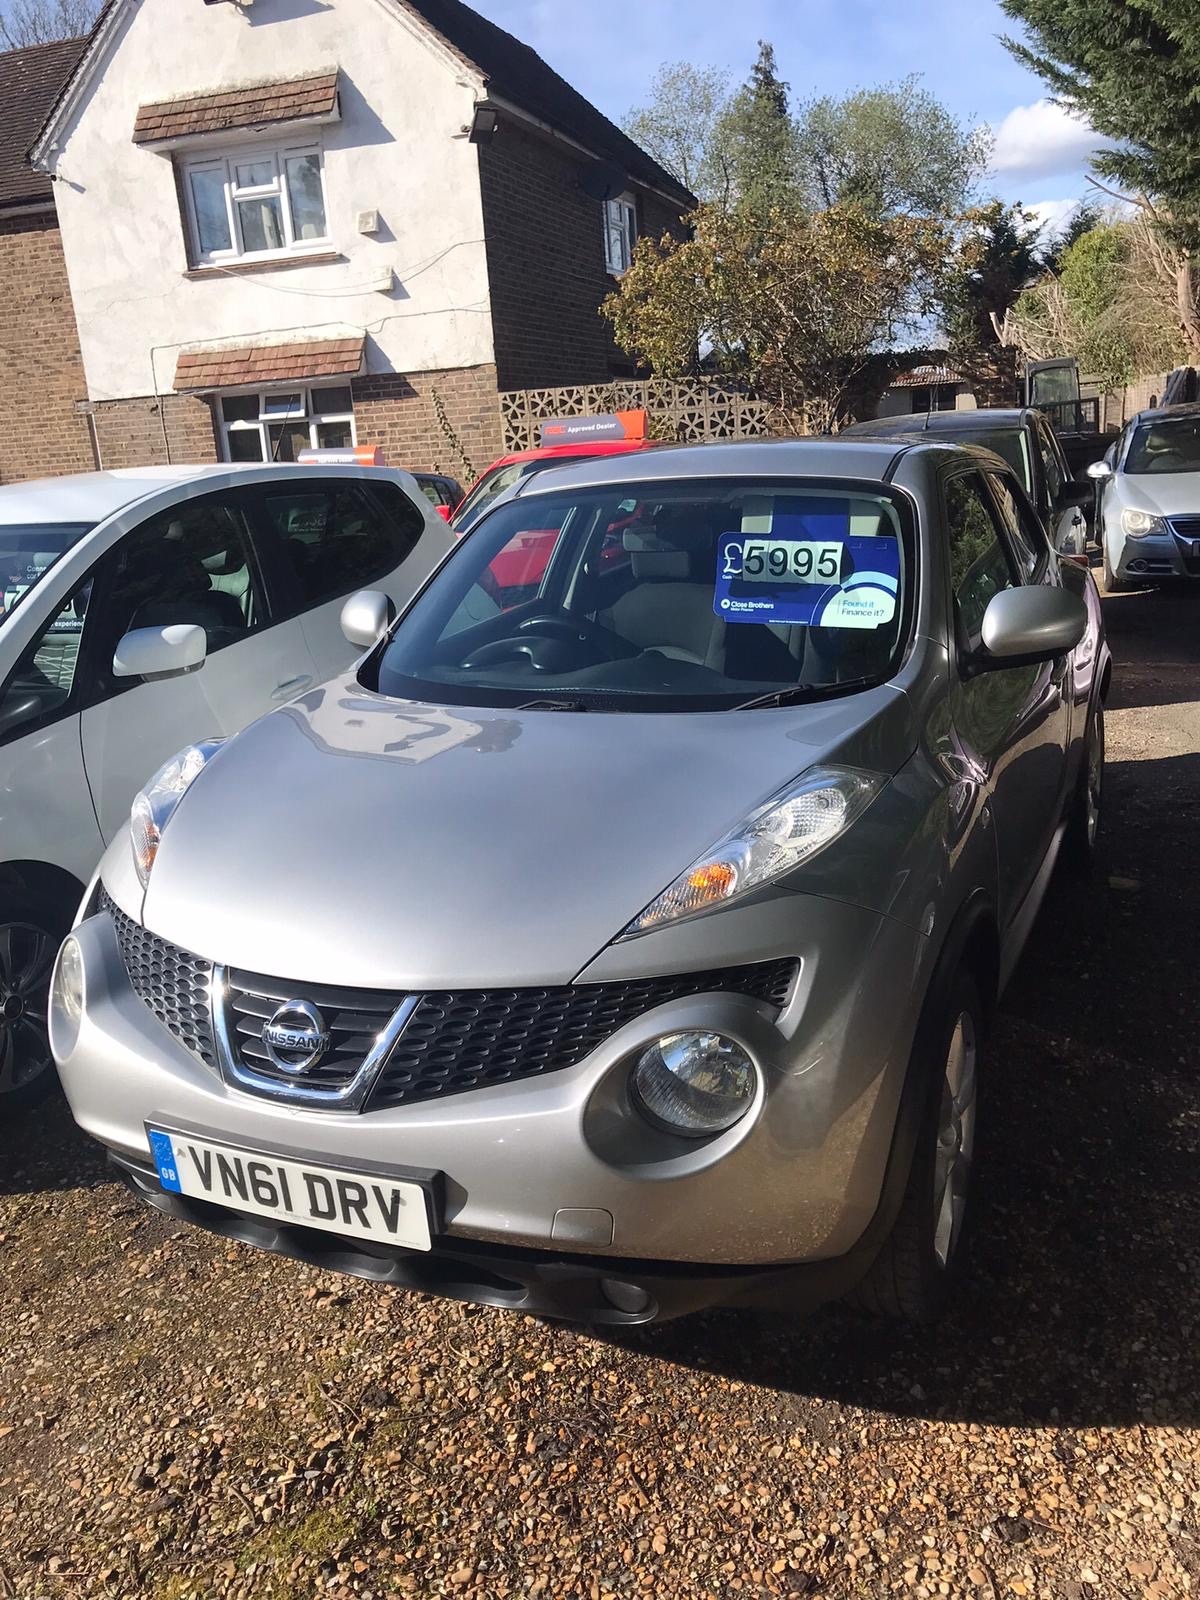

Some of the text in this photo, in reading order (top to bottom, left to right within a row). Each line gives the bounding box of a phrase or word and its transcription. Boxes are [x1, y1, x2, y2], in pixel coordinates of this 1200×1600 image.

[568, 424, 595, 434] Approved
[596, 422, 616, 430] Dealer
[748, 601, 774, 609] Brothers
[842, 608, 872, 616] Finance
[265, 1029, 320, 1050] NISSAN
[161, 1167, 176, 1181] GB
[187, 1145, 401, 1233] VN61 DRV
